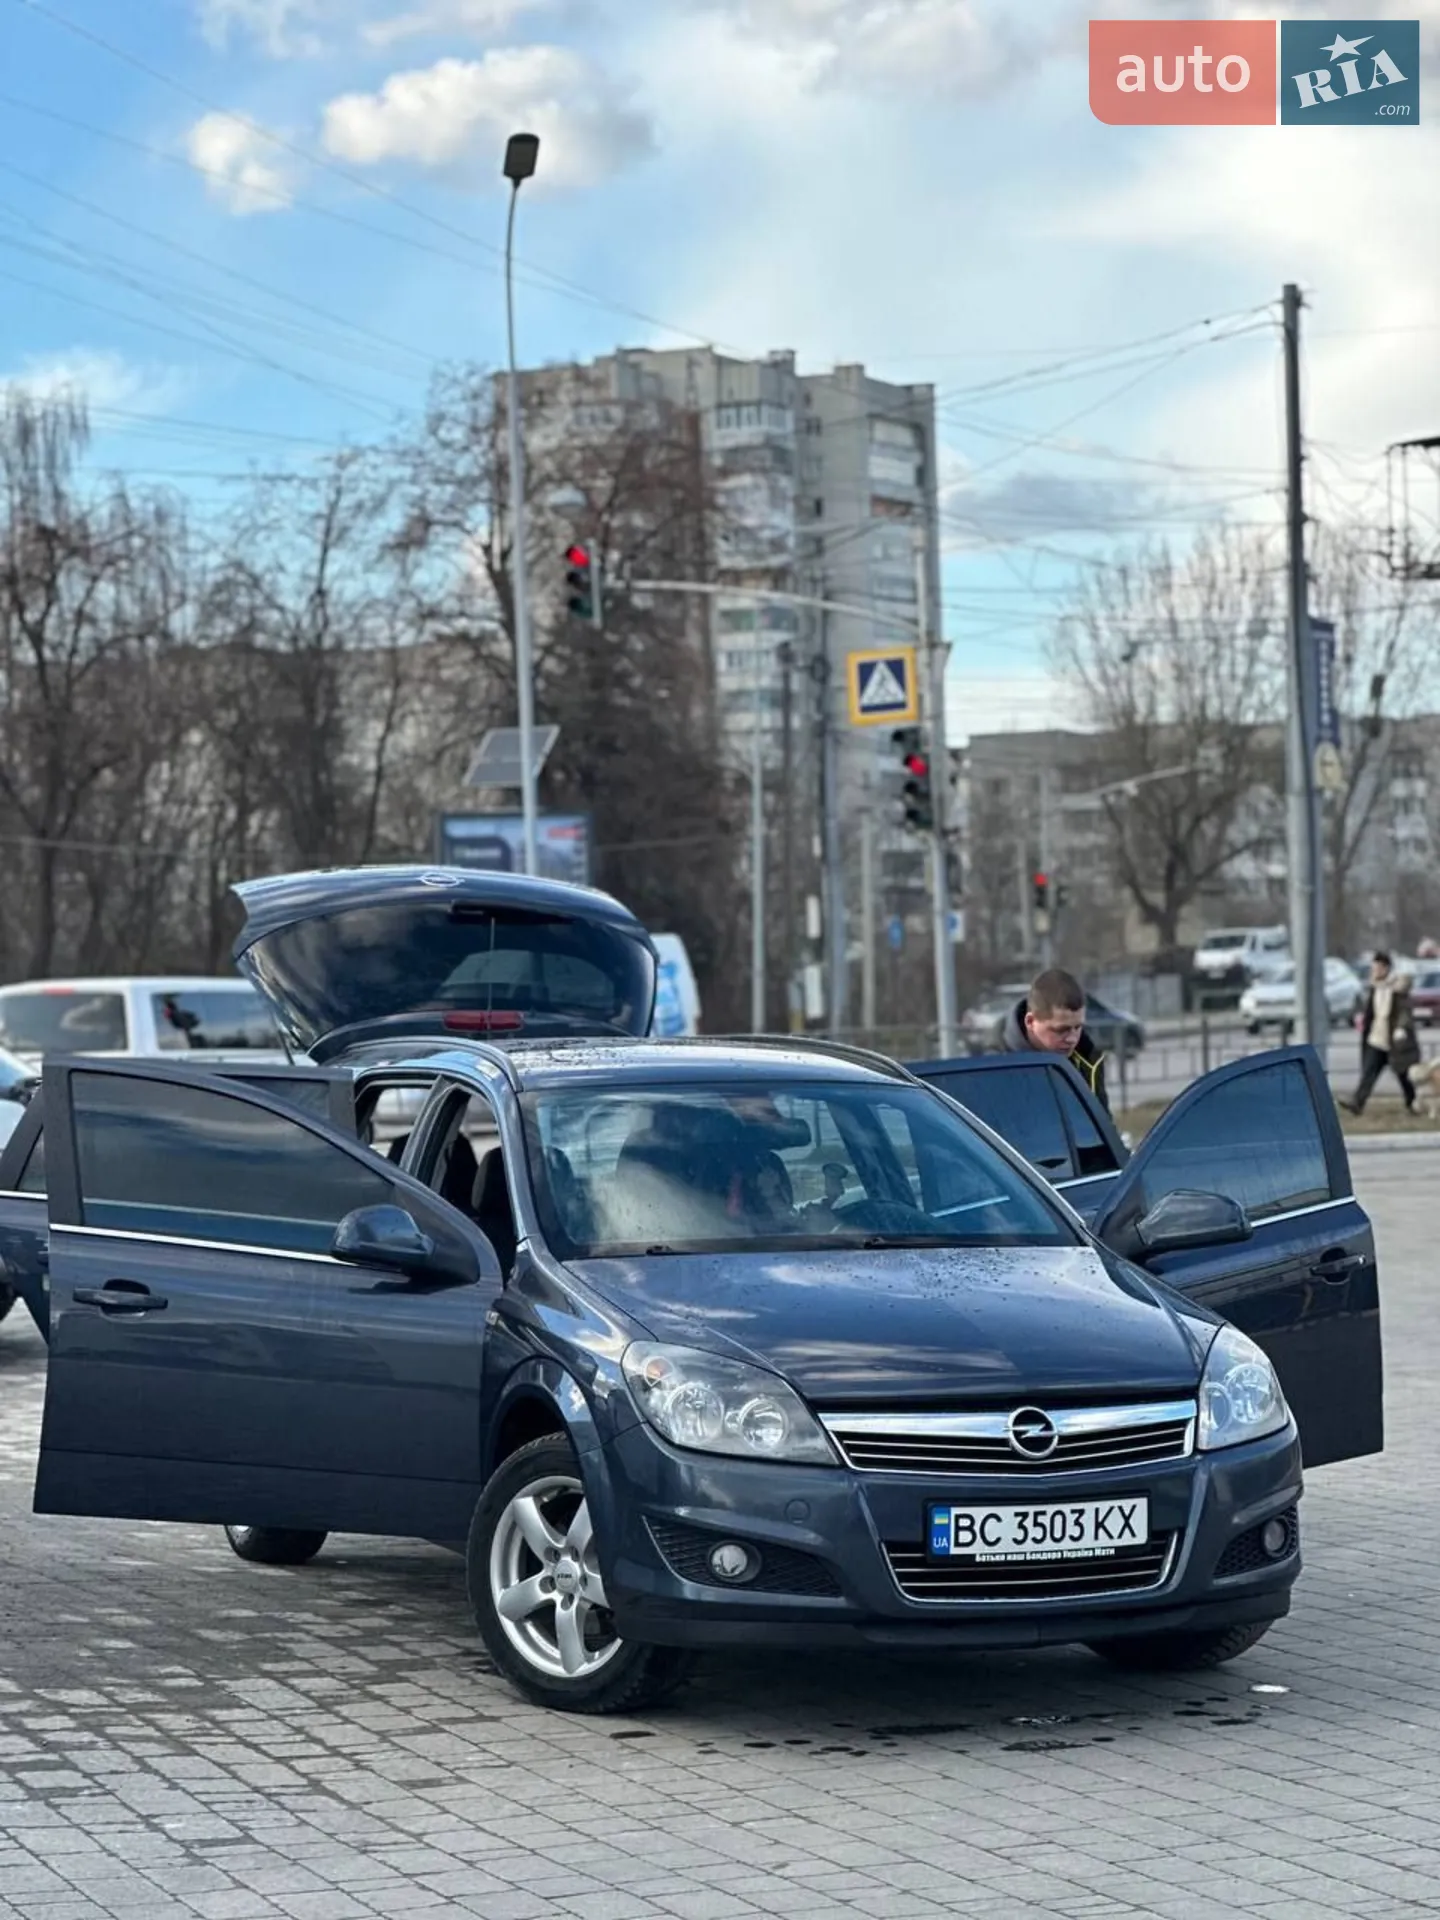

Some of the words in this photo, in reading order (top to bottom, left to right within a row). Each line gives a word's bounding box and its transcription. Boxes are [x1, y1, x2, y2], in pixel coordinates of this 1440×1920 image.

[953, 1513, 1003, 1548] BC
[1012, 1508, 1086, 1545] 3503
[1094, 1504, 1137, 1541] KX
[933, 1537, 949, 1549] UA
[975, 1553, 1006, 1563] Батько
